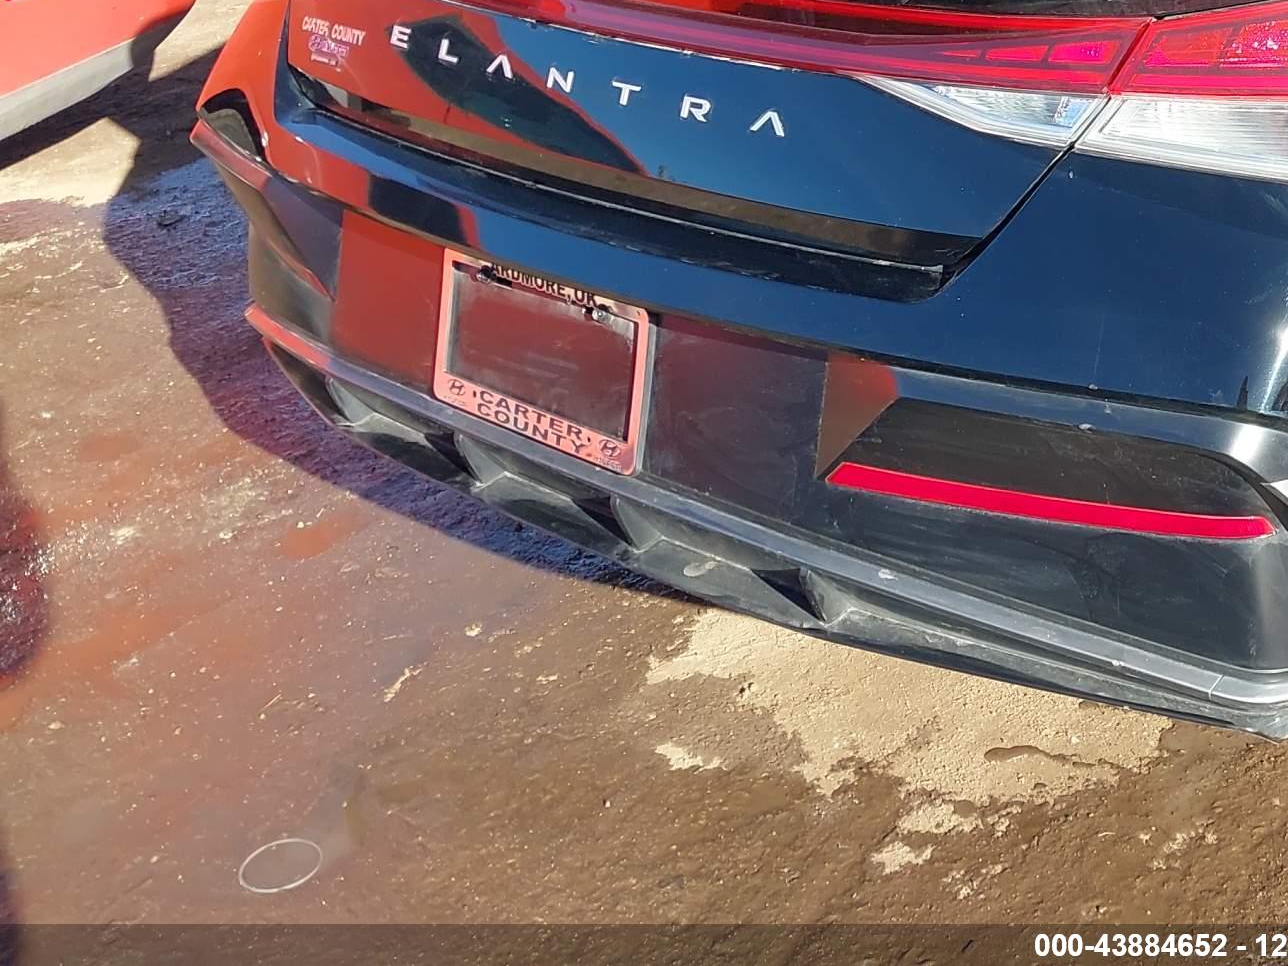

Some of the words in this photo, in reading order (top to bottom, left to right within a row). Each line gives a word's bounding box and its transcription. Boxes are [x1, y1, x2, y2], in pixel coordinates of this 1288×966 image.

[331, 23, 367, 46] COUNTY
[389, 24, 786, 138] ELANTRA
[477, 402, 589, 455] COUNTY
[479, 390, 585, 441] CARTER
